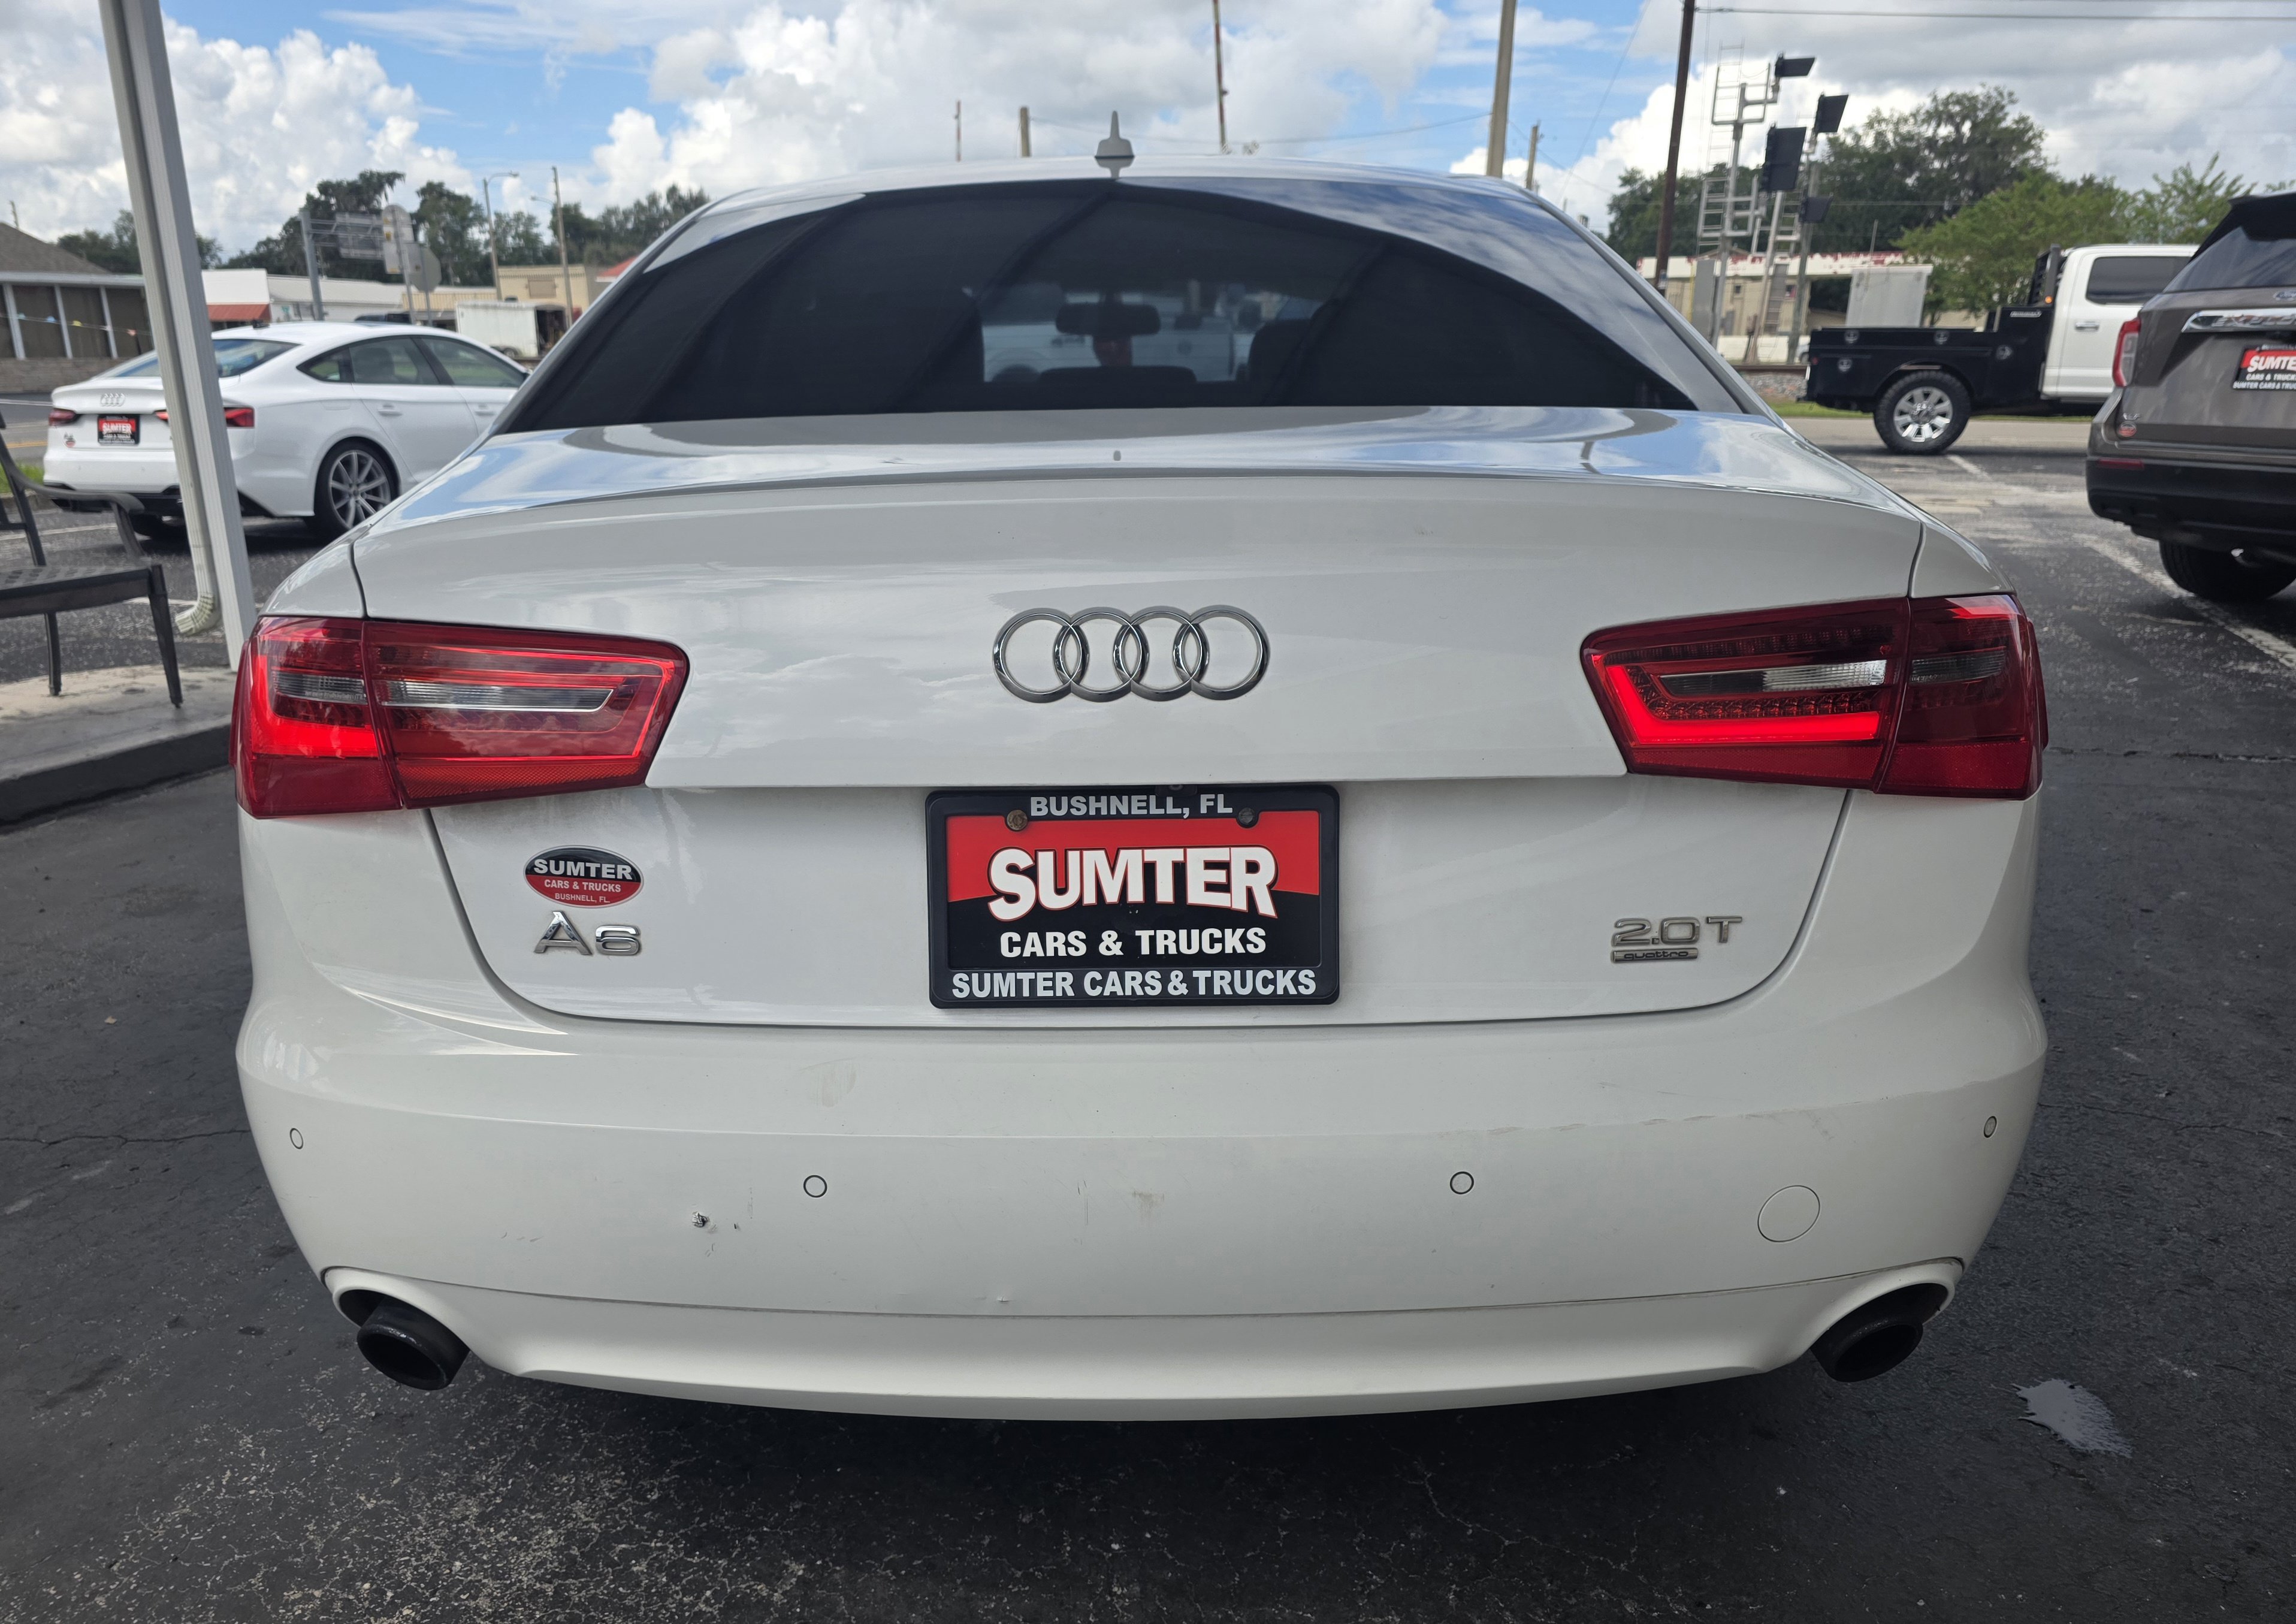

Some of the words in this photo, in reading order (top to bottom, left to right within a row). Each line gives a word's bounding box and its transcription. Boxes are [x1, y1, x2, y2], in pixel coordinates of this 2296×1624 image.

[2212, 314, 2296, 327] EXPLO
[2247, 355, 2296, 372] SUMTE
[102, 422, 132, 435] SUMTER
[1030, 795, 1190, 819] BUSHNELL,
[1200, 793, 1234, 814] FL
[533, 859, 633, 880] SUMTER
[544, 879, 569, 889] CARS
[572, 881, 579, 890] &
[582, 882, 621, 892] TRUCKS
[987, 845, 1278, 922] SUMTER
[555, 893, 597, 903] BUSHNELL,
[533, 910, 641, 956] A6
[1000, 930, 1087, 958] CARS
[1098, 929, 1124, 955] &
[1135, 928, 1267, 955] TRUCKS
[1624, 951, 1689, 960] quattro
[951, 971, 1074, 999] SUMTER
[1083, 970, 1162, 997] CARS
[1167, 970, 1189, 995] &
[1192, 968, 1316, 996] TRUCKS
